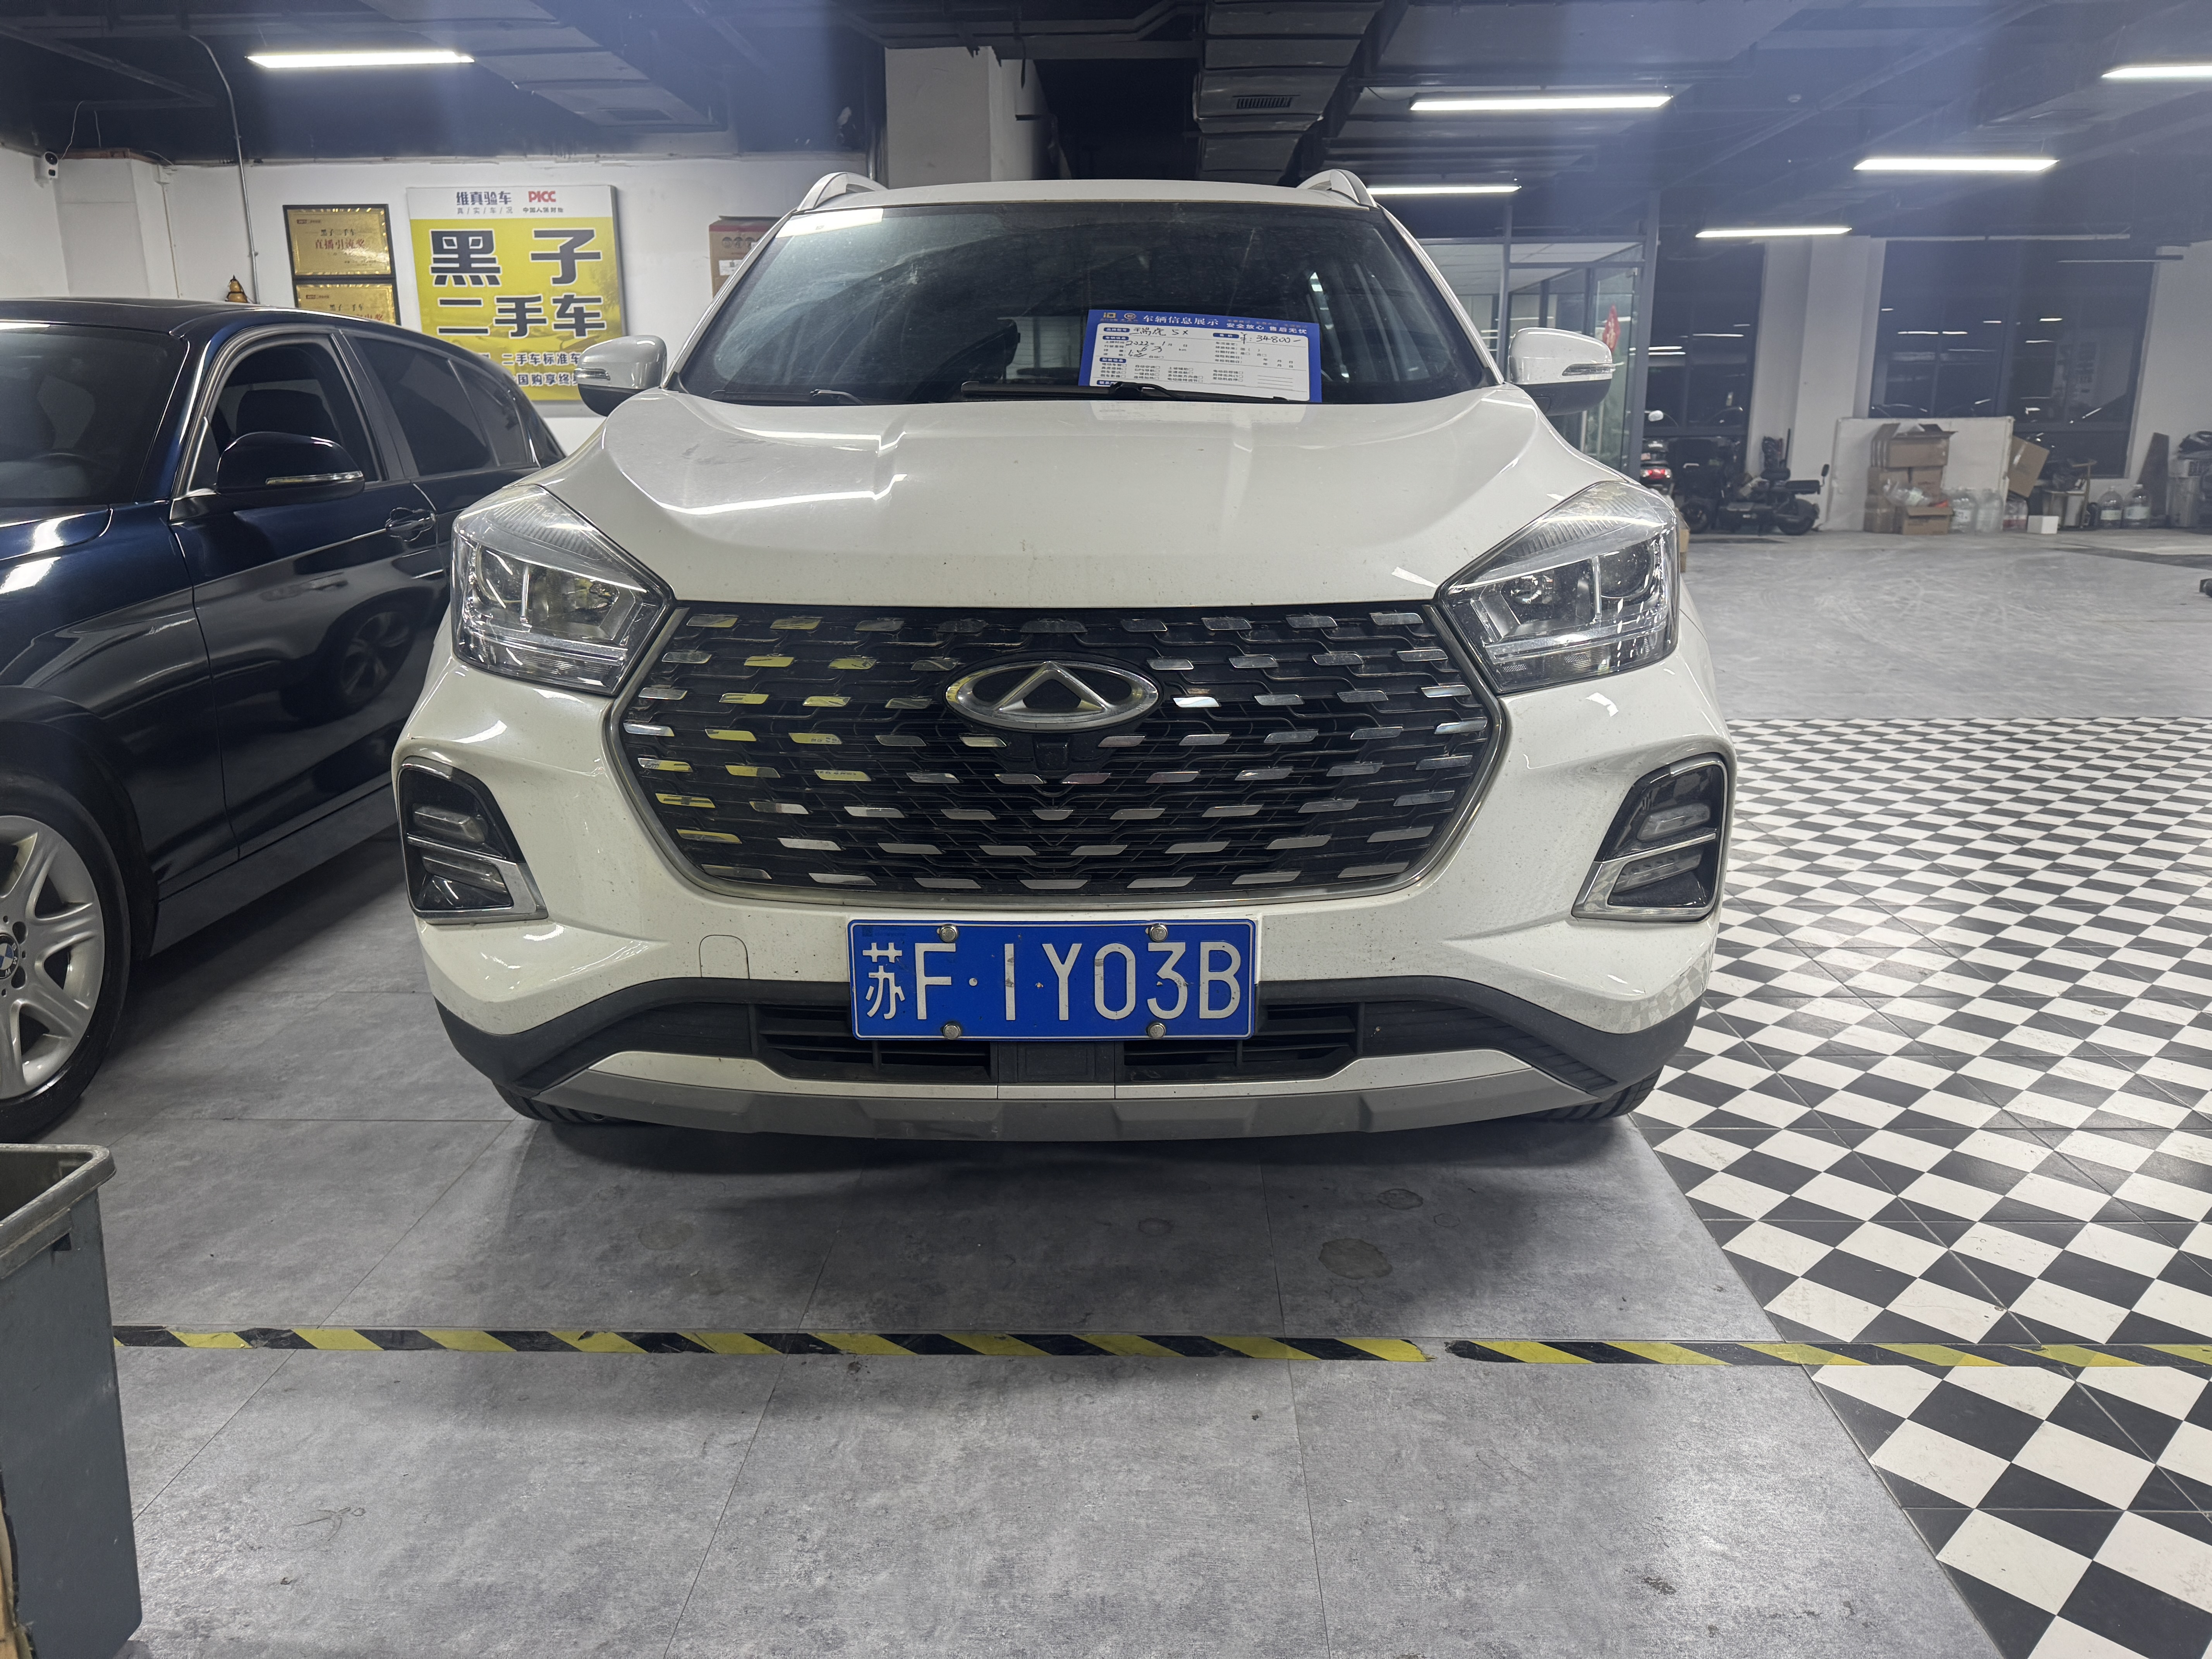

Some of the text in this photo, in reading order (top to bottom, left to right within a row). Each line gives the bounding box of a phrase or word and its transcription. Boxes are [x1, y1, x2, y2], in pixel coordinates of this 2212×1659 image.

[456, 191, 512, 205] 维真验车
[528, 191, 556, 203] PICC
[437, 293, 606, 338] 二手车
[1143, 314, 1219, 326] 车辆信息展示
[502, 352, 581, 366] 二手车标准车
[5, 942, 18, 976] BMW
